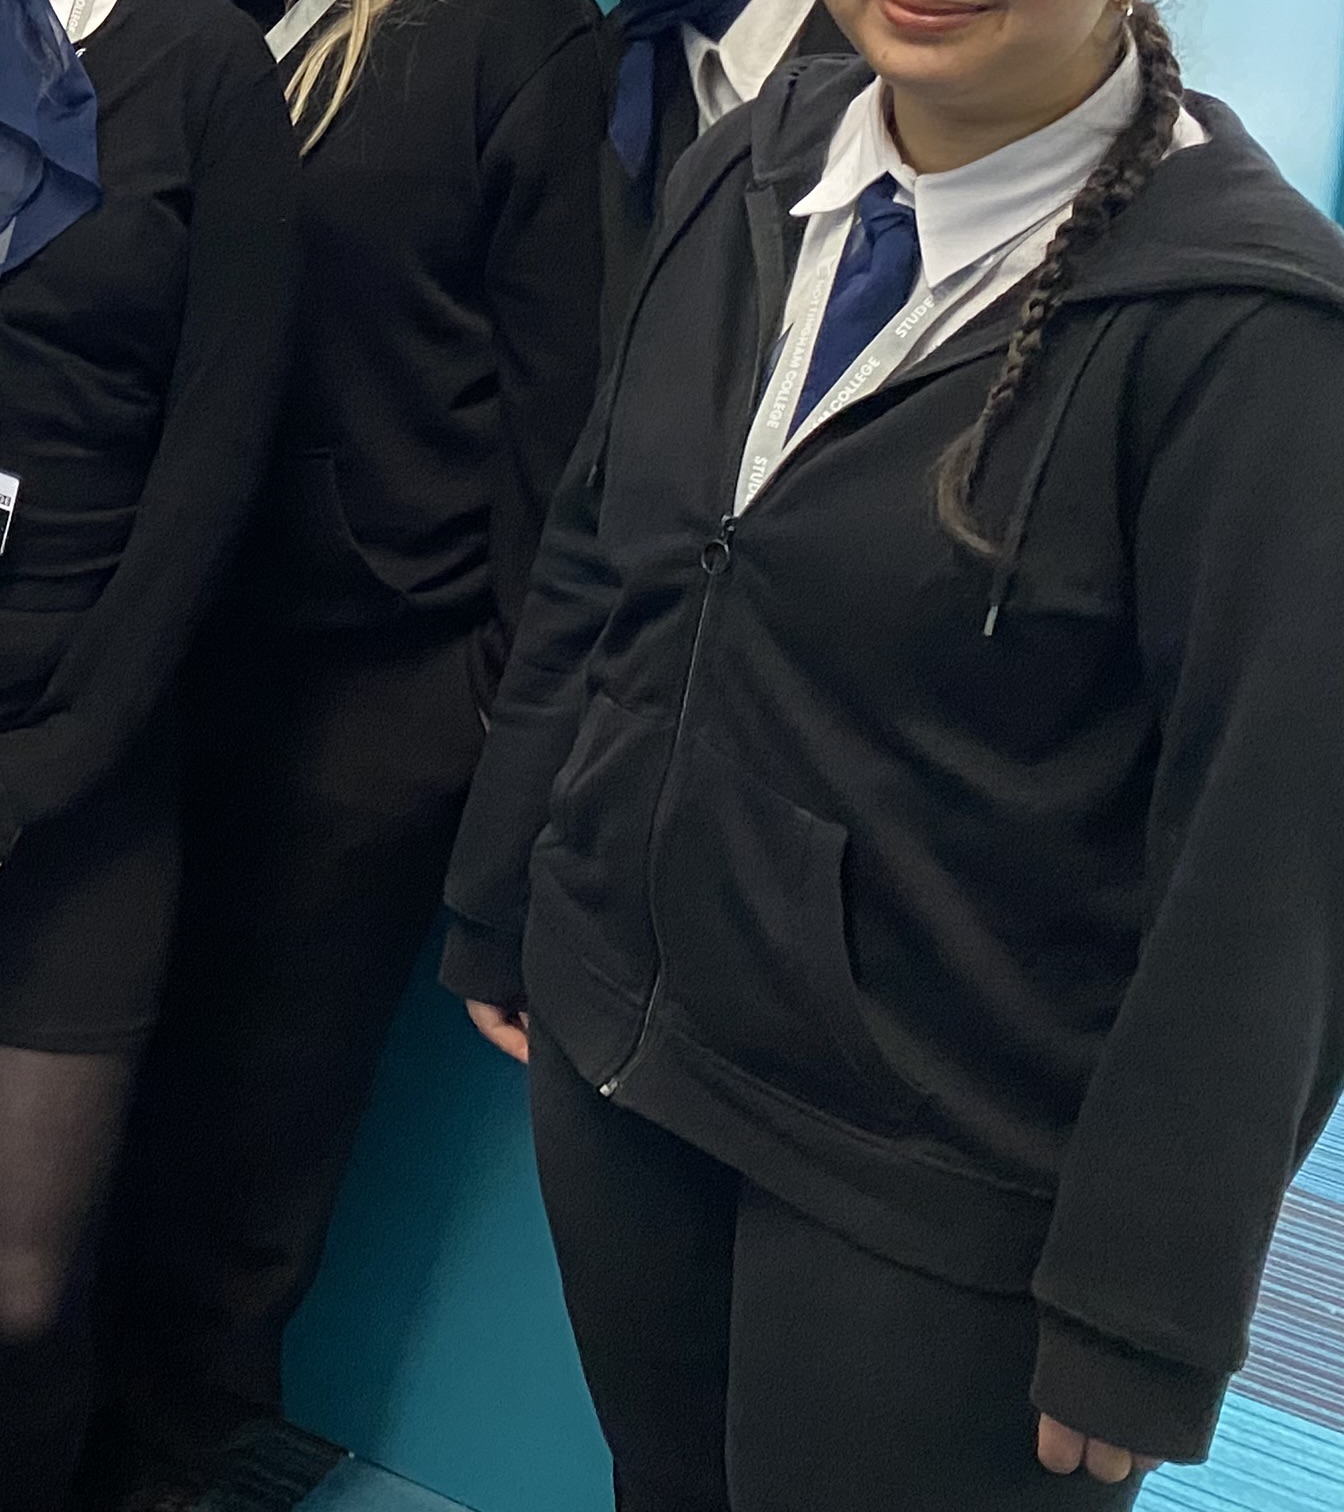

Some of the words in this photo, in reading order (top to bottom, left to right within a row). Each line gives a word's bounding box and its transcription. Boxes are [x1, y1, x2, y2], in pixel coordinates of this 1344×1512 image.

[788, 280, 827, 369] NOTTINGHAM
[895, 294, 936, 339] STUDE
[766, 367, 799, 430] COLLEGE
[829, 355, 882, 412] COLLEGE
[745, 454, 770, 505] STUD
